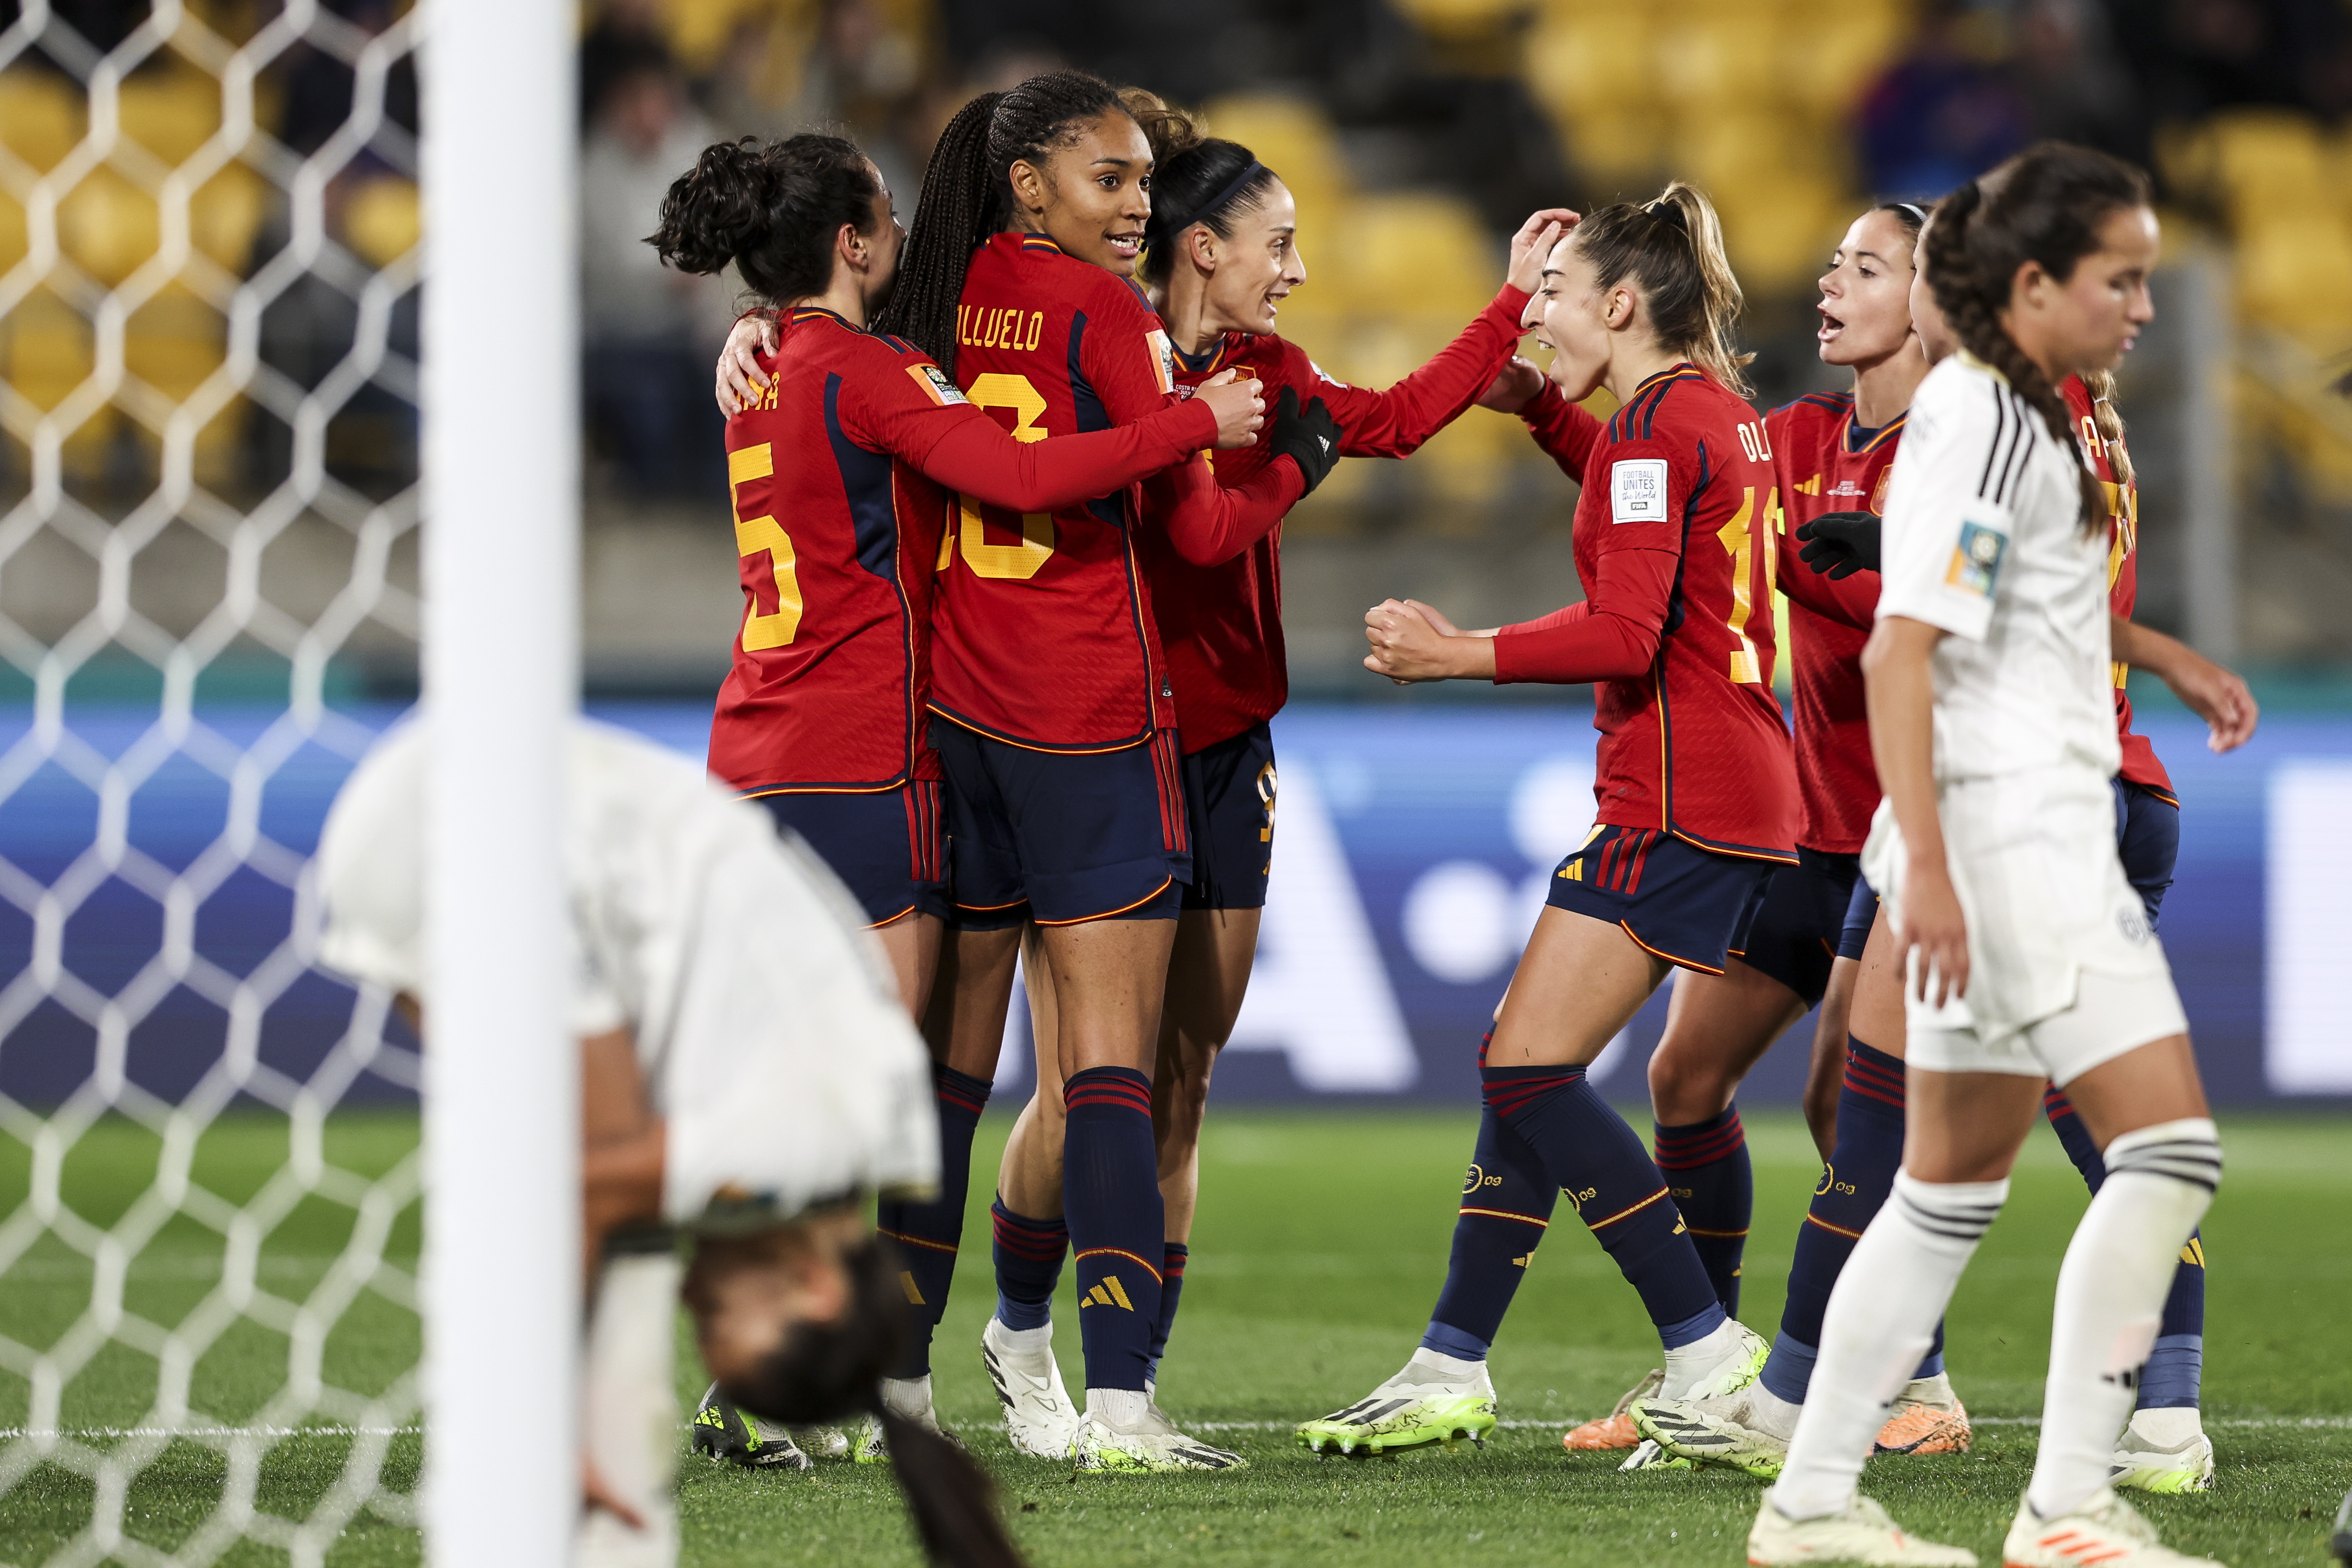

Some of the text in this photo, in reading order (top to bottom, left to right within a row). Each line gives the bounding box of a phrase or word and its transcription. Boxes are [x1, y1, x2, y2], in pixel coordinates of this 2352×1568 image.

[1623, 471, 1654, 479] FOOTBALL
[1623, 479, 1654, 490] UNITES
[1621, 491, 1656, 501] the World
[728, 442, 803, 653] 5
[1484, 1176, 1502, 1186] 09
[1671, 1188, 1693, 1198] 09
[1835, 1182, 1856, 1195] 09
[1578, 1187, 1597, 1201] 09
